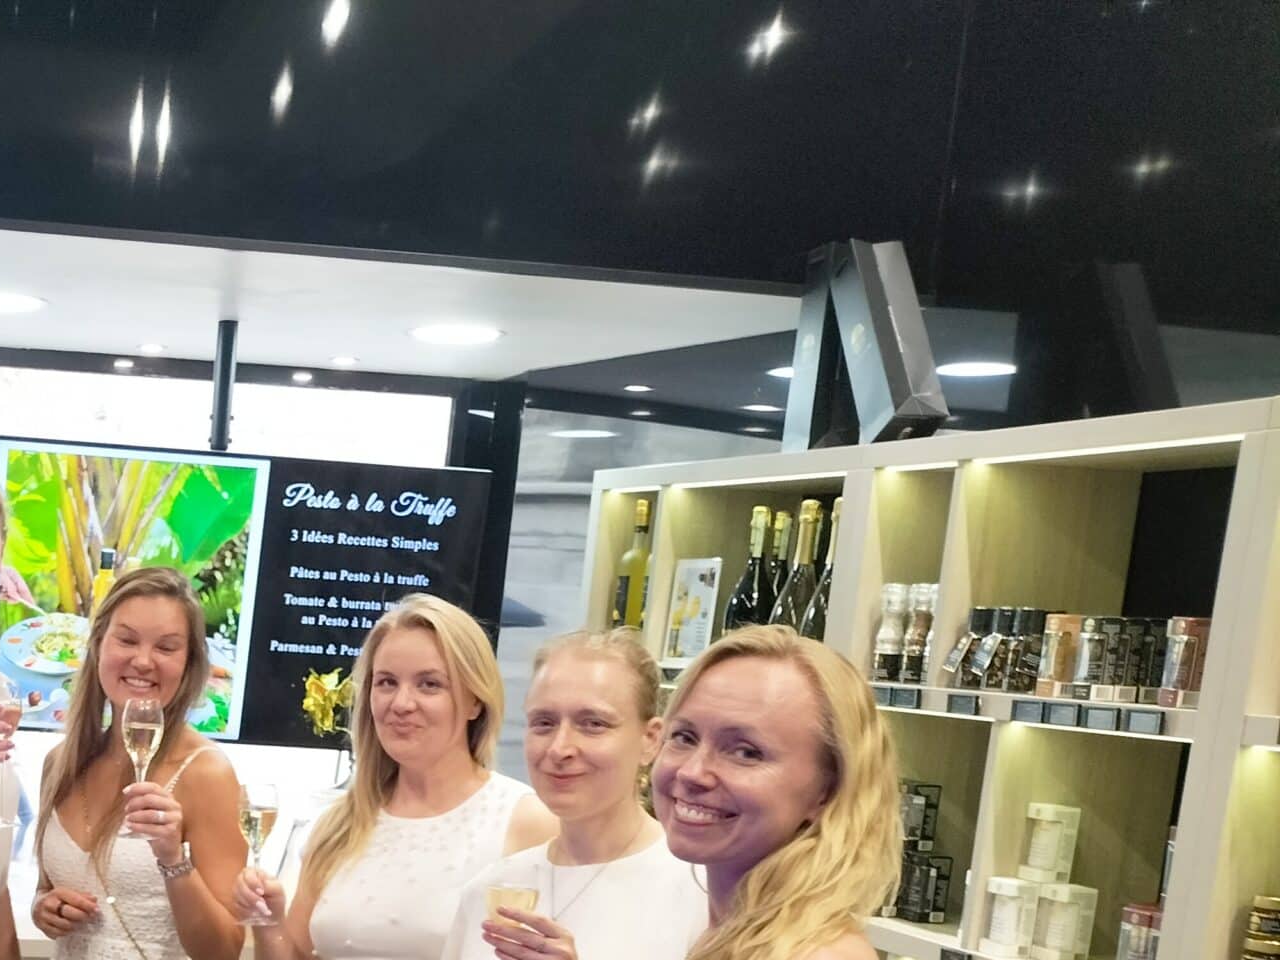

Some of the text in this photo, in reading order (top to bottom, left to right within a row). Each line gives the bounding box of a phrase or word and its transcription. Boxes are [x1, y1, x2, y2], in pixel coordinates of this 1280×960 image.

[282, 483, 457, 525] Pesto à la Truffe
[290, 529, 440, 552] 3 Idées Recettes Simples
[289, 566, 430, 587] Pâtes au Pesto à la truffe
[283, 593, 325, 607] Tomate
[327, 596, 339, 608] &
[341, 597, 381, 611] burrata
[301, 614, 373, 629] au Pesto à la
[270, 639, 323, 655] Parmesan
[326, 643, 337, 656] &
